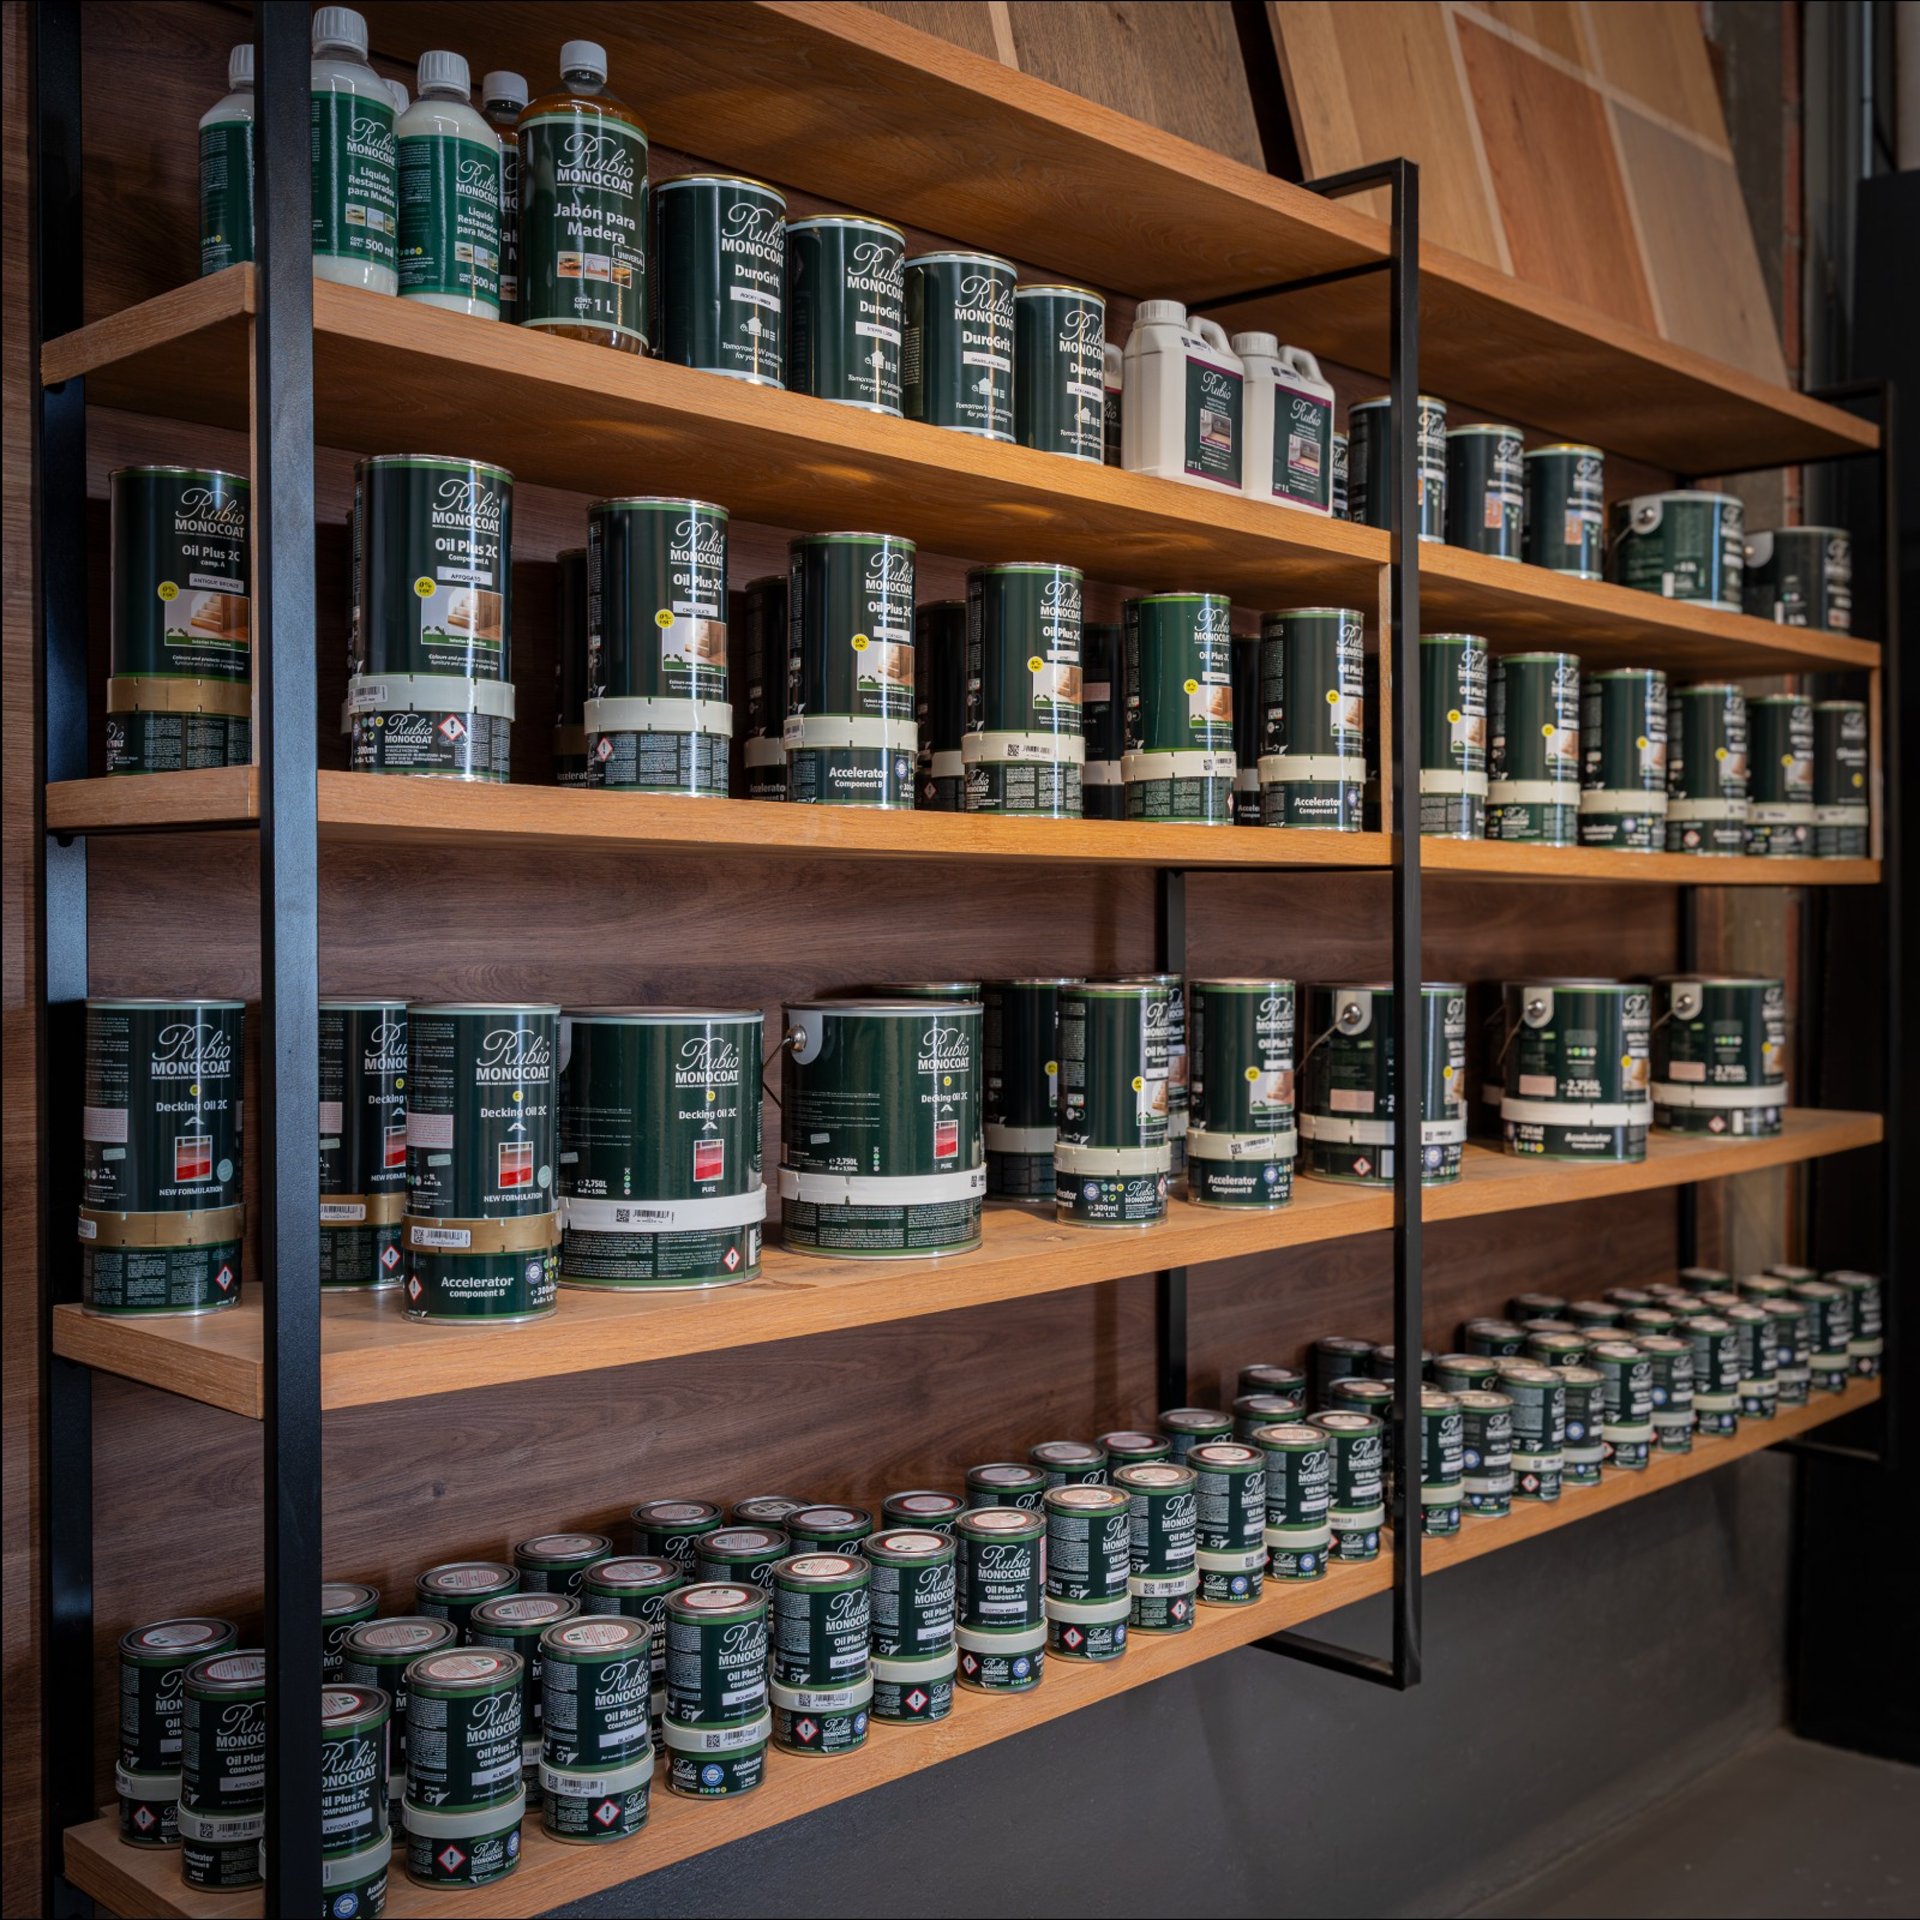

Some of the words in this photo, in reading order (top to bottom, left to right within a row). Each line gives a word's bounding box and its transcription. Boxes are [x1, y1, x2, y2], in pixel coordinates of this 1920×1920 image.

[347, 117, 396, 155] Rubio
[347, 141, 396, 165] MONOCOAT
[558, 132, 634, 179] Rubio
[348, 174, 394, 197] Restaurador
[456, 159, 498, 195] Rubio
[557, 168, 634, 194] MONOCOAT
[347, 186, 369, 199] para
[370, 190, 395, 208] Madera
[457, 214, 498, 234] Restaurador
[554, 202, 602, 220] Jabón
[606, 211, 636, 231] para
[457, 226, 476, 239] para
[567, 221, 626, 244] Madera
[721, 202, 784, 251] Rubio
[365, 238, 384, 253] 500
[384, 244, 394, 258] ml
[721, 238, 784, 268] MONOCOAT
[847, 242, 904, 286] Rubio
[735, 263, 780, 288] DuroGrit
[473, 276, 489, 289] 500
[489, 282, 497, 294] ml
[847, 276, 904, 303] MONOCOAT
[955, 275, 1014, 318] Rubio
[595, 298, 601, 312] 1
[606, 299, 614, 314] L
[860, 300, 901, 322] DuroGrit
[954, 308, 1014, 331] MONOCOAT
[962, 330, 1011, 352] DuroGrit
[1200, 370, 1232, 400] Rubio
[1290, 398, 1321, 427] Rubio
[175, 487, 244, 525] Rubio
[432, 478, 500, 518] Rubio
[175, 518, 244, 539] MONOCOAT
[432, 511, 500, 533] MONOCOAT
[670, 519, 723, 555] Rubio
[182, 544, 199, 557] Oil
[202, 546, 225, 560] Plus
[228, 550, 240, 562] 2C
[435, 537, 455, 552] Oil
[457, 541, 484, 556] Plus
[486, 544, 498, 559] 2C
[200, 559, 220, 568] comp.
[448, 553, 484, 565] Component
[670, 549, 723, 567] MONOCOAT
[865, 551, 913, 584] Rubio
[193, 577, 218, 586] ANTIQUE
[418, 580, 432, 589] 0%
[451, 573, 481, 582] AFFOGATO
[673, 573, 690, 586] Oil
[691, 576, 713, 590] Plus
[865, 579, 912, 596] MONOCOAT
[1040, 580, 1081, 609] Rubio
[868, 601, 882, 613] Oil
[884, 603, 903, 616] Plus
[385, 713, 433, 736] Rubio
[384, 735, 433, 744] MONOCOAT
[829, 766, 888, 779] Accelerator
[834, 779, 878, 789] Component
[878, 780, 883, 788] B
[1294, 796, 1341, 807] Accelerator
[1299, 807, 1333, 815] Component
[151, 1023, 231, 1061] Rubio
[476, 1029, 549, 1066] Rubio
[918, 1027, 969, 1058] Rubio
[675, 1037, 739, 1071] Rubio
[151, 1060, 231, 1075] MONOCOAT
[917, 1057, 969, 1070] MONOCOAT
[476, 1065, 549, 1081] MONOCOAT
[675, 1069, 739, 1084] MONOCOAT
[156, 1101, 200, 1113] Decking
[203, 1100, 216, 1111] Oil
[217, 1099, 227, 1110] 2C
[368, 1094, 404, 1105] Decking
[921, 1093, 951, 1104] Decking
[952, 1092, 961, 1101] Oil
[480, 1107, 523, 1119] Decking
[525, 1106, 537, 1116] Oil
[538, 1105, 547, 1116] 2C
[678, 1109, 715, 1121] Decking
[717, 1108, 727, 1119] Oil
[728, 1107, 737, 1117] 2C
[370, 1173, 385, 1182] NEW
[585, 1178, 608, 1188] 2,750L
[1208, 1174, 1257, 1186] Accelerator
[159, 1188, 176, 1196] NEW
[178, 1185, 223, 1196] FORMULATION
[484, 1194, 501, 1203] NEW
[501, 1192, 543, 1202] FORMULATION
[1125, 1180, 1155, 1198] Rubio
[1211, 1185, 1245, 1194] Component
[1094, 1204, 1119, 1212] 300ml
[441, 1276, 514, 1288] Accelerator
[450, 1288, 497, 1299] component
[499, 1288, 505, 1297] B
[978, 1545, 1031, 1570] Rubio
[978, 1566, 1031, 1579] MONOCOAT
[984, 1585, 997, 1593] Oil
[997, 1584, 1014, 1593] Plus
[1016, 1583, 1025, 1592] 2C
[826, 1588, 869, 1621] Rubio
[922, 1609, 933, 1620] Oil
[934, 1606, 947, 1617] Plus
[826, 1609, 870, 1632] MONOCOAT
[718, 1620, 767, 1655] Rubio
[834, 1636, 846, 1646] Oil
[846, 1633, 861, 1645] Plus
[718, 1643, 767, 1666] MONOCOAT
[595, 1658, 649, 1695] Rubio
[727, 1671, 740, 1681] Oil
[741, 1667, 756, 1680] Plus
[595, 1681, 649, 1707] MONOCOAT
[735, 1691, 758, 1702] BOURBON
[467, 1689, 521, 1731] Rubio
[605, 1713, 617, 1723] Oil
[618, 1709, 635, 1722] Plus
[165, 1718, 181, 1729] Oil
[466, 1714, 521, 1743] MONOCOAT
[607, 1716, 639, 1730] COMPONENT
[617, 1734, 635, 1744] BLACK
[226, 1754, 241, 1766] Oil
[476, 1748, 491, 1760] Oil
[492, 1743, 509, 1757] Plus
[479, 1752, 512, 1768] COMPONENT
[732, 1755, 763, 1772] Accelerator
[492, 1767, 512, 1779] ALMOND
[672, 1769, 697, 1781] MONOCOAT
[334, 1792, 357, 1807] Plus
[358, 1787, 370, 1800] 2C
[325, 1819, 359, 1832] AFFOGATO
[471, 1851, 503, 1866] MONOCOAT
[473, 1840, 503, 1860] Rubio
